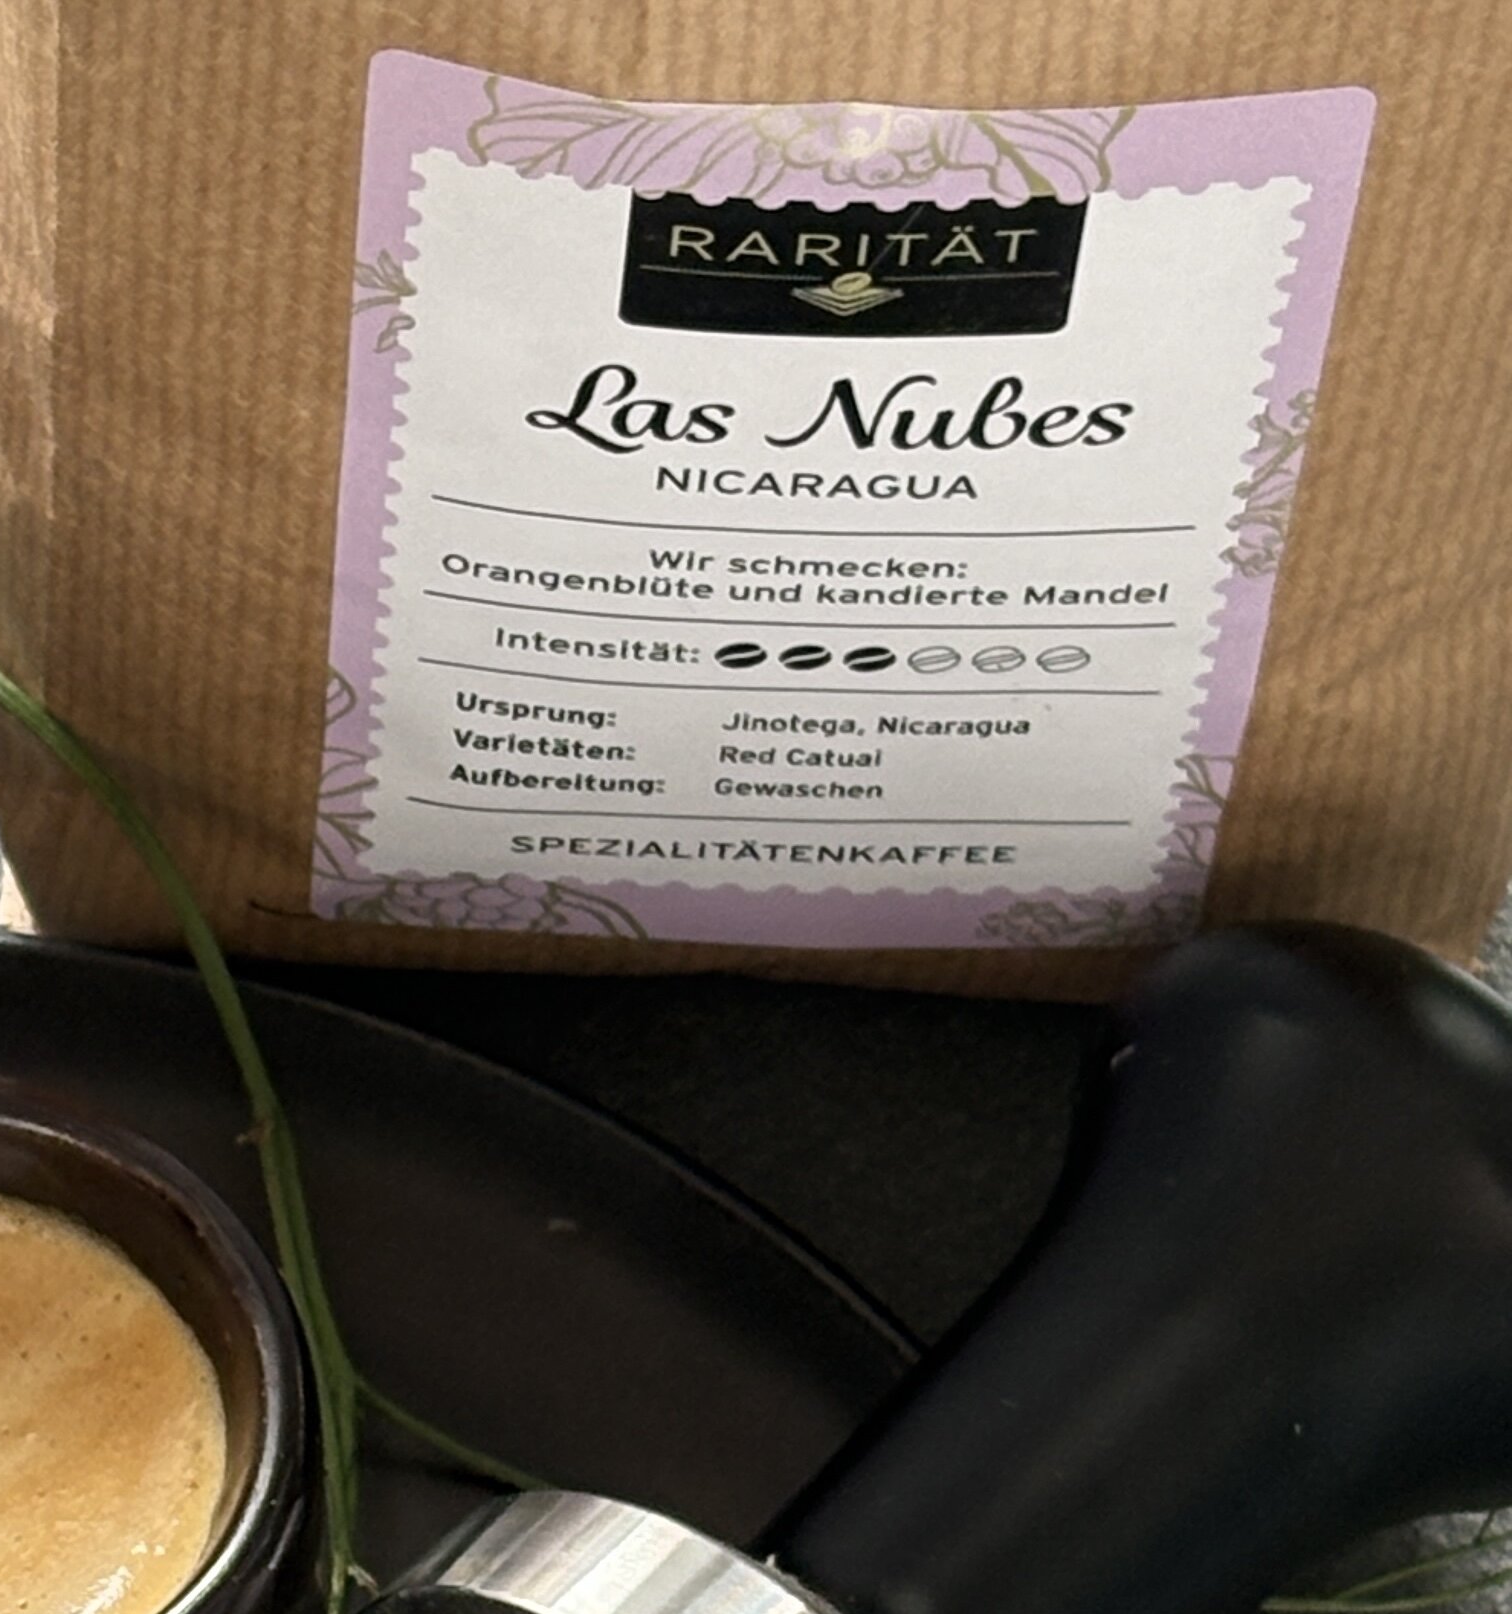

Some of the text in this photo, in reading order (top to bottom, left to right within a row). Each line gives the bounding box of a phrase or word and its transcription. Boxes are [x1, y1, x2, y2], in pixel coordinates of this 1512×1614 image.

[668, 225, 1038, 268] RARITÄT
[524, 363, 1135, 455] Las Nubes
[654, 466, 979, 500] NICARAGUA
[441, 553, 1169, 606] Orangenblüte und kandierte Mandel
[648, 549, 968, 579] Wir schmecken:
[495, 627, 700, 663] Intensität:
[456, 691, 617, 729] Ursprung:
[721, 713, 1031, 738] Jinotega, Nicaragua
[453, 728, 637, 761] Varietäten:
[718, 745, 776, 765] Red
[449, 764, 666, 796] Aufbereitung:
[713, 778, 884, 799] Gewaschen
[510, 835, 1018, 864] SPEZIALITÄTENKAFFEE
